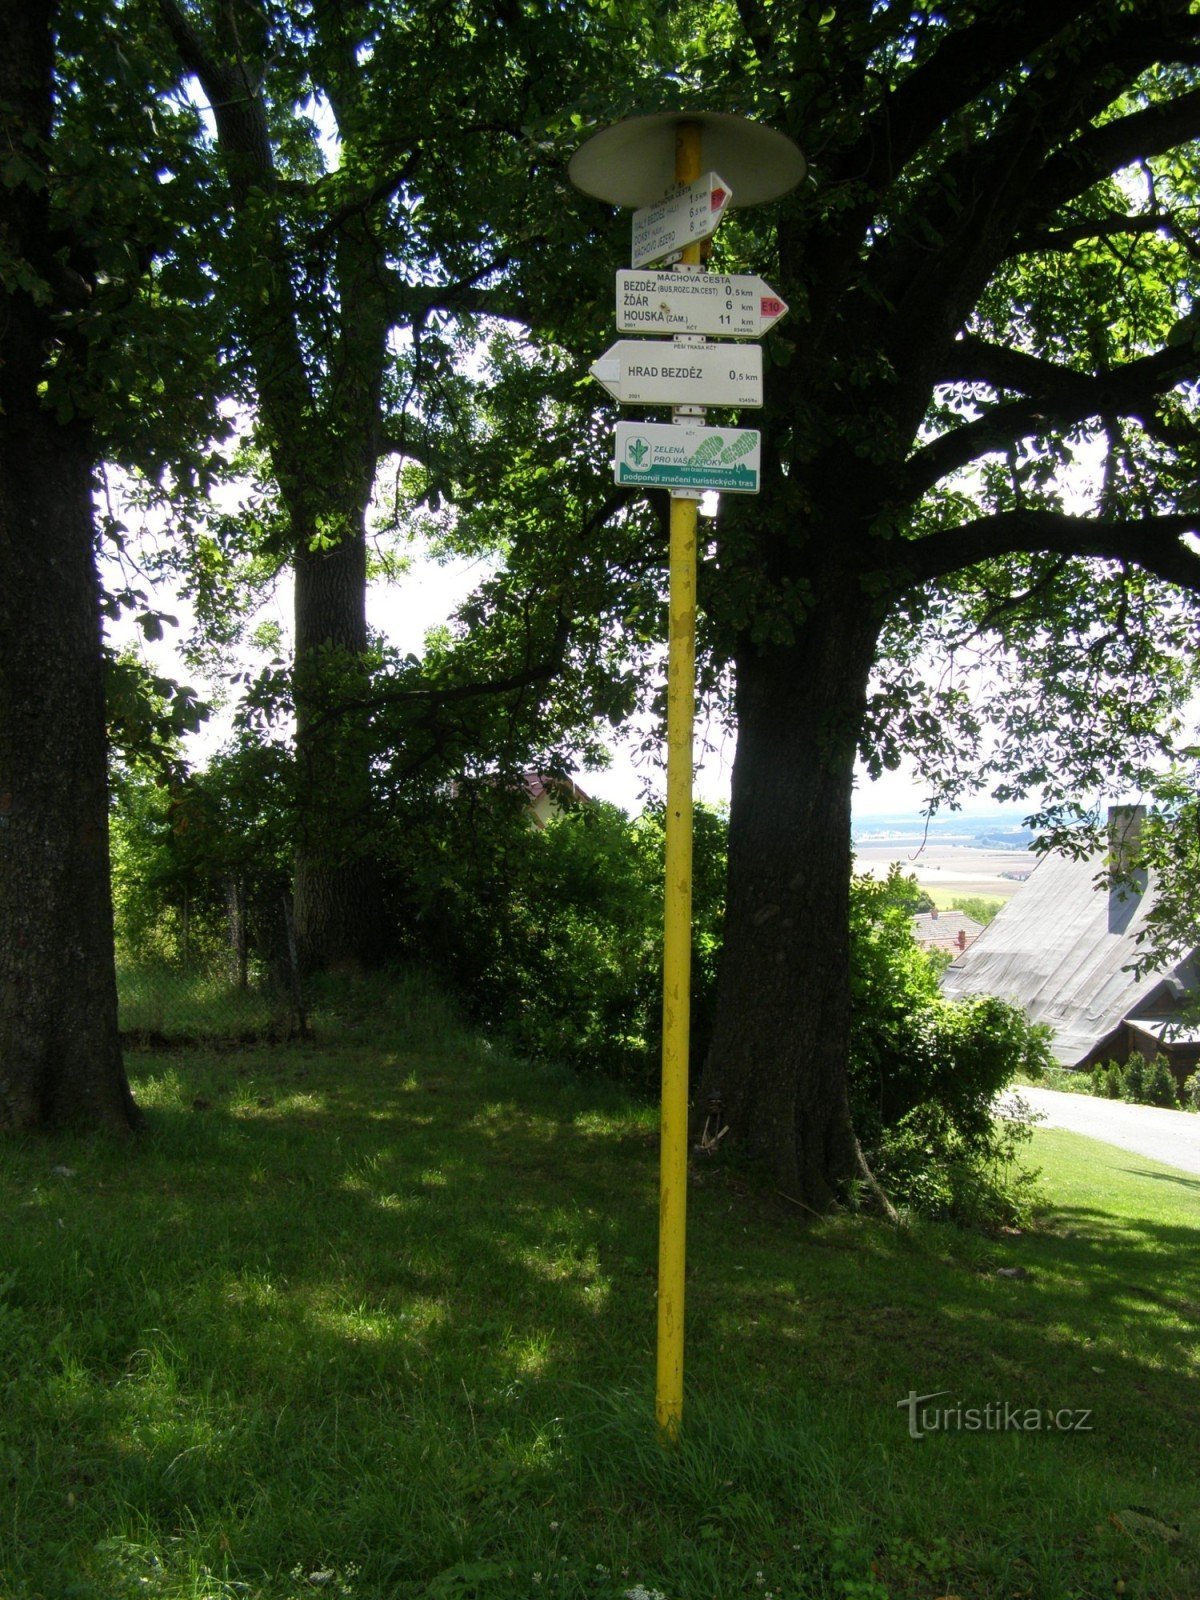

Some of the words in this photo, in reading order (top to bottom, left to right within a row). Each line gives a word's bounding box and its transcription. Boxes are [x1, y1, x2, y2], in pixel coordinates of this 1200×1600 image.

[657, 272, 701, 283] MÁCHOVA
[702, 276, 731, 285] CESTA
[623, 279, 657, 292] BEZDĚZ
[741, 289, 753, 297] km
[623, 293, 649, 306] ŽĎÁR
[725, 300, 733, 310] 6
[741, 303, 753, 311] km
[761, 302, 780, 312] E10
[623, 310, 665, 322] HOUSKA
[718, 314, 731, 325] 11
[741, 318, 754, 326] km
[628, 366, 658, 377] HRAD
[661, 366, 703, 379] BEZDĚZ
[745, 373, 758, 382] km
[654, 445, 685, 454] ZELENÁ
[653, 456, 669, 464] PRO
[673, 456, 692, 466] VAŠE
[623, 473, 660, 483] podporují
[661, 475, 691, 483] značení
[692, 477, 737, 487] turistických
